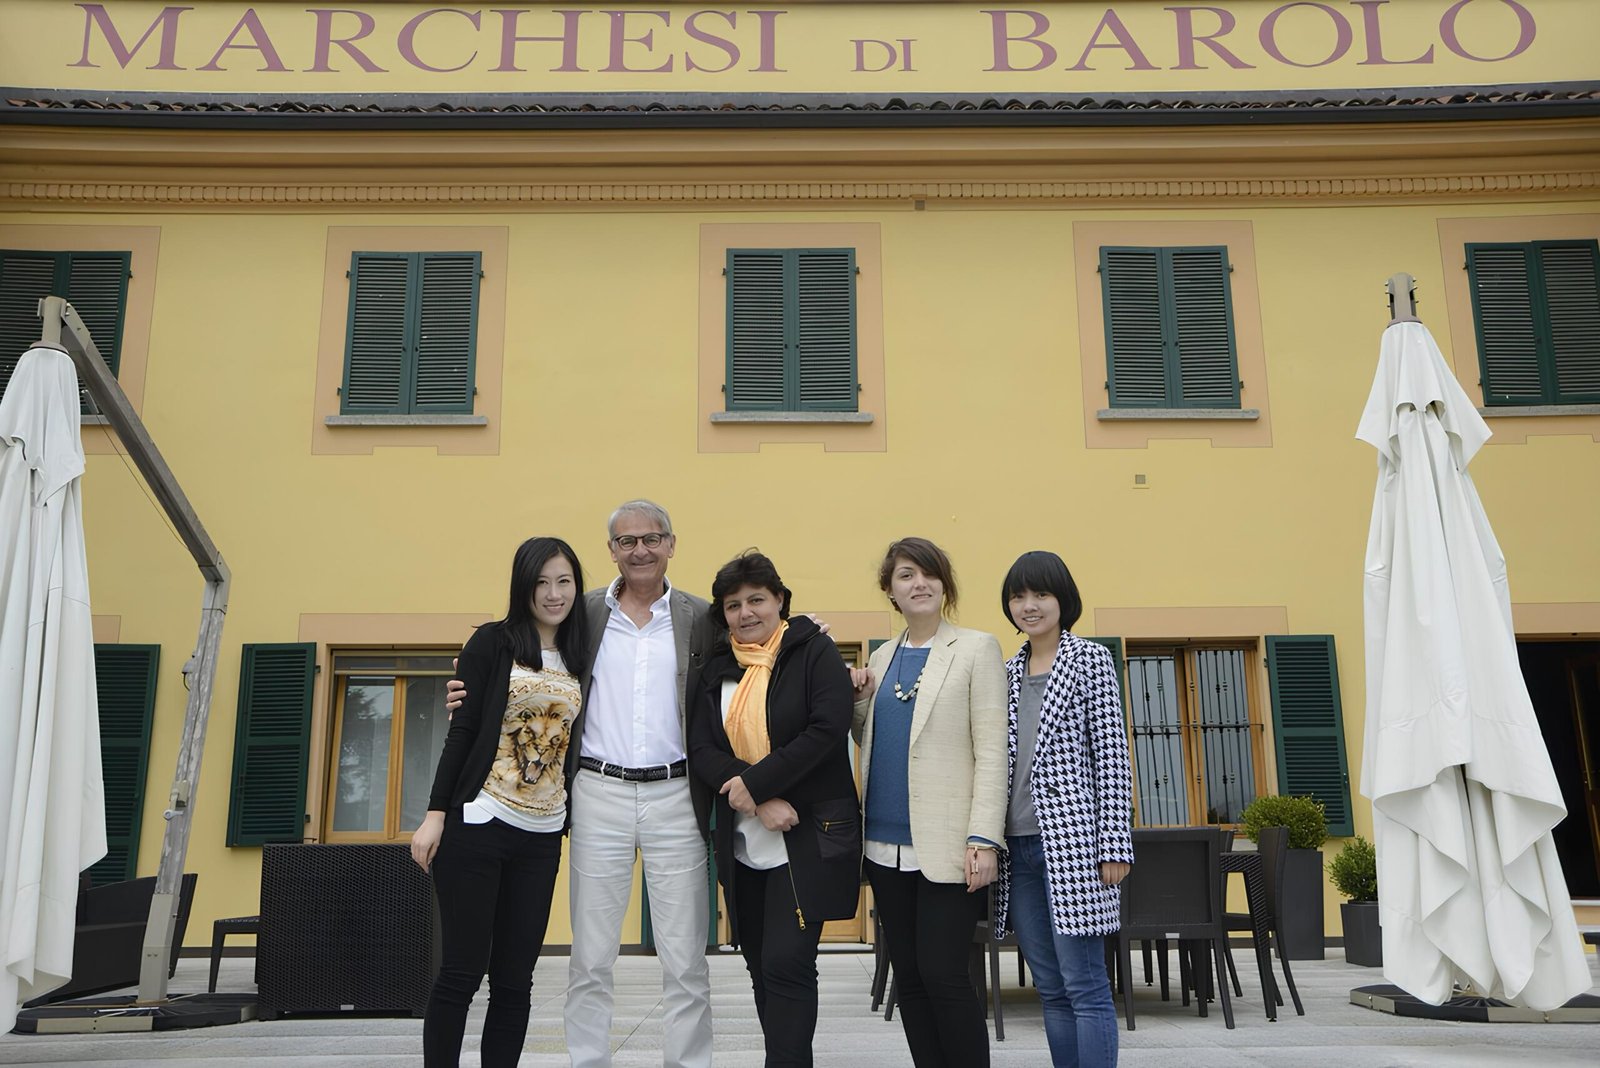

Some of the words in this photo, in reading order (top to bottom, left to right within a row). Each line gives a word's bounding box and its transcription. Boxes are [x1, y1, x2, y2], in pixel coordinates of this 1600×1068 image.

[66, 3, 788, 73] MARCHESI
[849, 39, 918, 72] DI
[980, 0, 1537, 71] BAROLO
